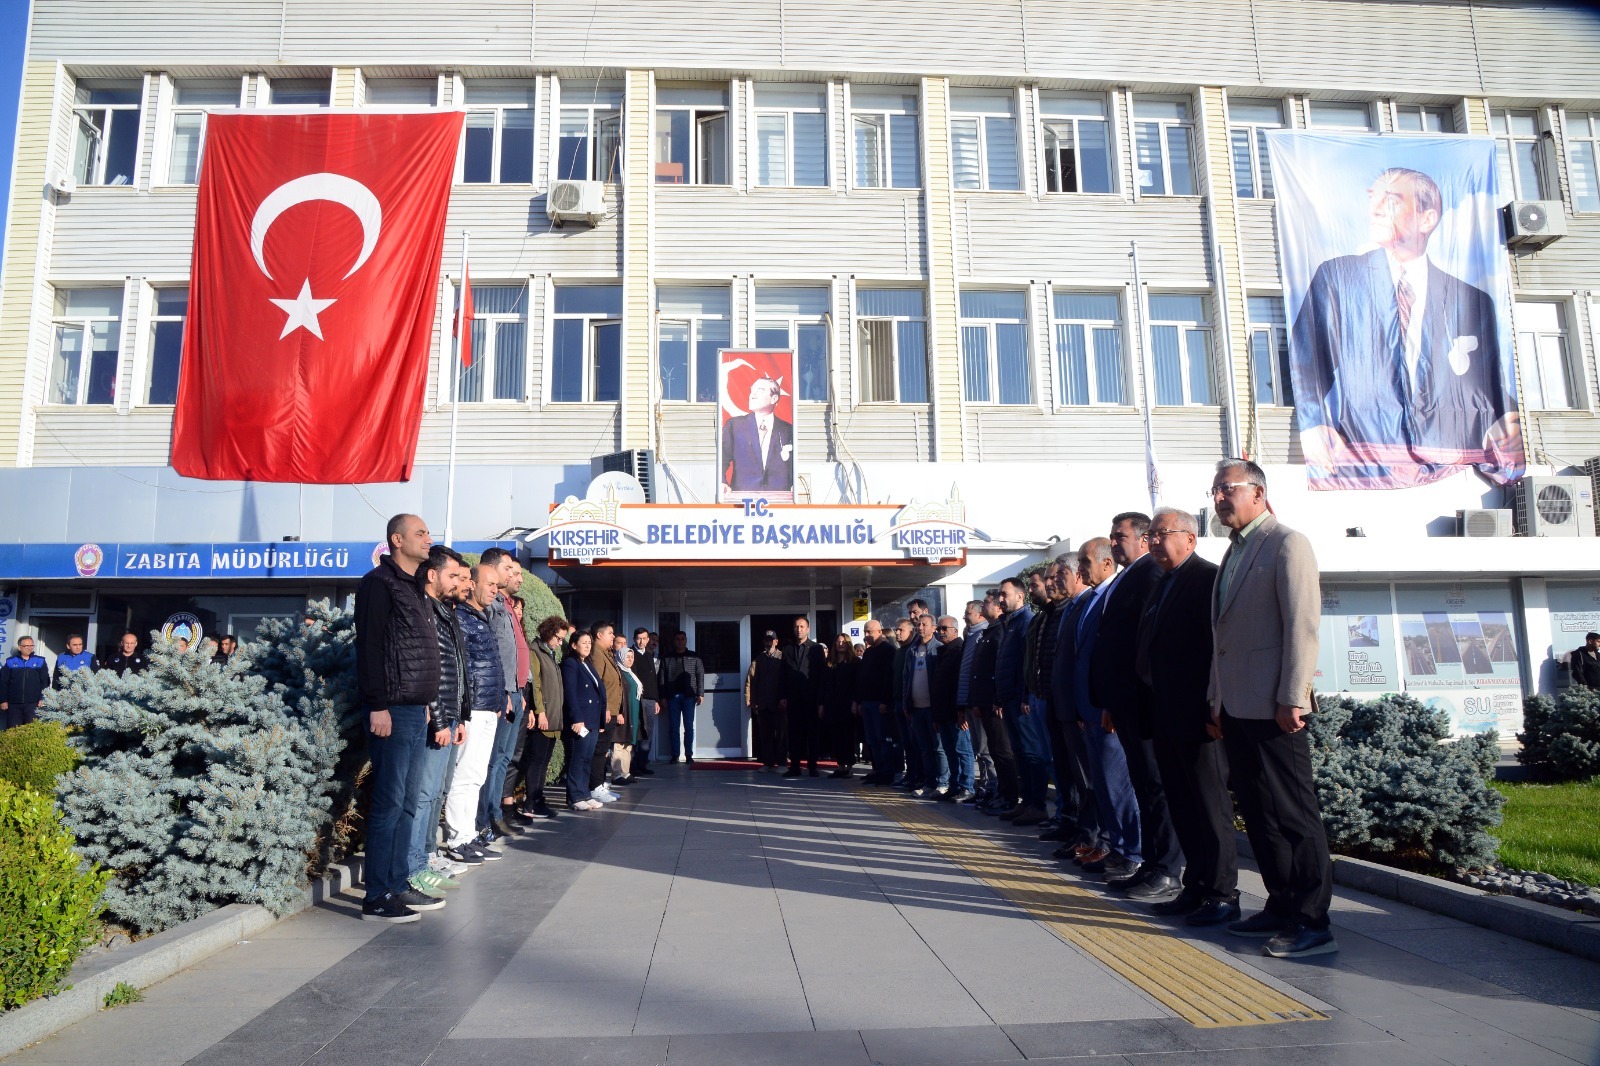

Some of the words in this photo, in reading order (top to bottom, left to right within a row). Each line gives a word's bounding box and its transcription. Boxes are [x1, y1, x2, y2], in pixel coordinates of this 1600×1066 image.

[742, 498, 774, 518] T.C.
[550, 529, 620, 546] KIRŞEHİR
[647, 519, 745, 544] BELEDİYE
[752, 519, 873, 549] BAŞKANLIĞI
[899, 529, 967, 545] KIRŞEHİR
[124, 552, 201, 569] ZABITA
[211, 548, 349, 569] MÜDÜRLÜĞÜ
[563, 547, 608, 556] BELEDİYESİ
[912, 546, 956, 555] BELEDİYESİ
[1463, 697, 1491, 716] SU
